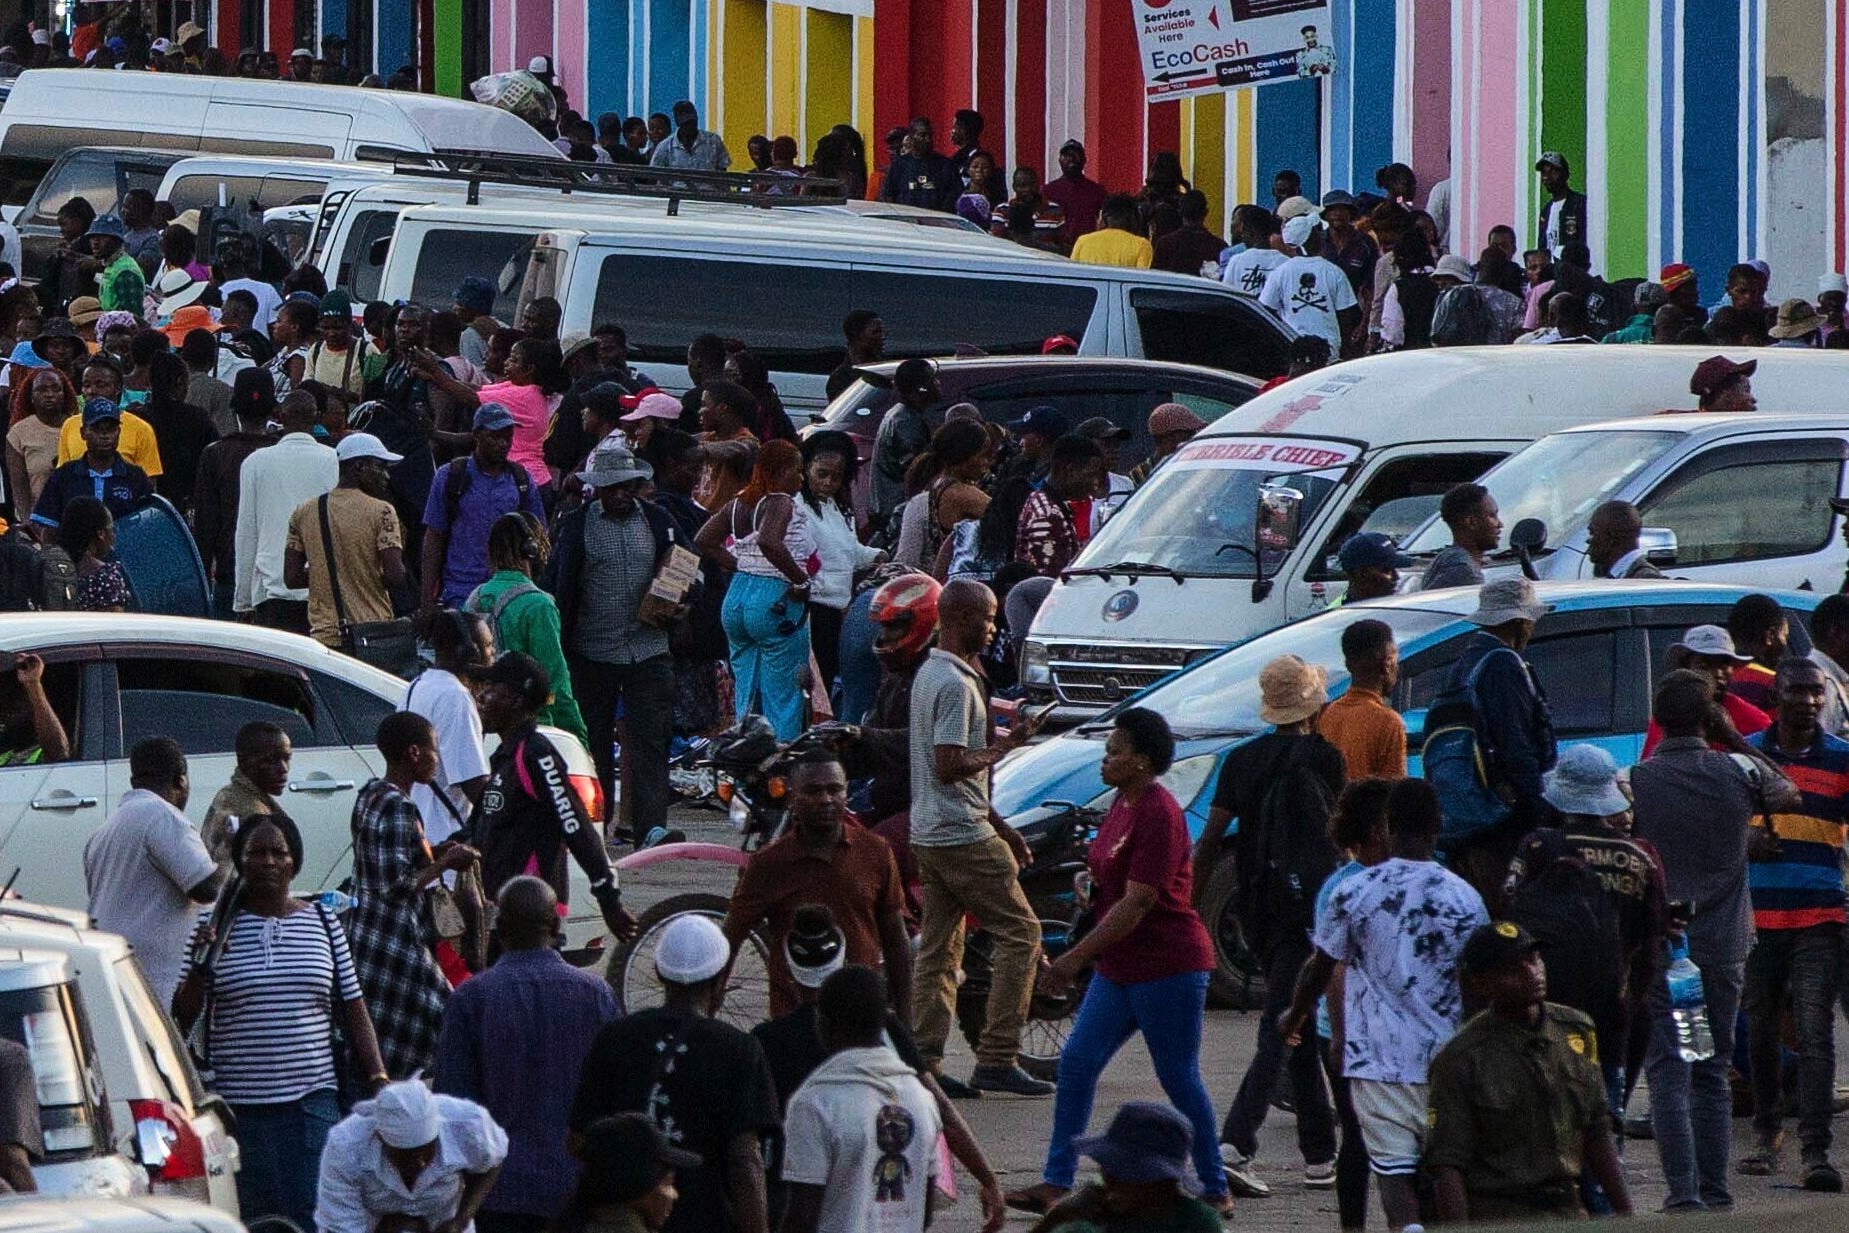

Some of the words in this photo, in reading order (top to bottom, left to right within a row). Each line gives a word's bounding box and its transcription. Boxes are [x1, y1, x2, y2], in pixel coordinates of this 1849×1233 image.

[1144, 7, 1191, 23] Services
[1144, 18, 1196, 34] Available
[1158, 32, 1184, 44] Here
[1152, 37, 1249, 70] EcoCash
[1270, 445, 1347, 467] CHIEF
[538, 754, 581, 835] DUARIG
